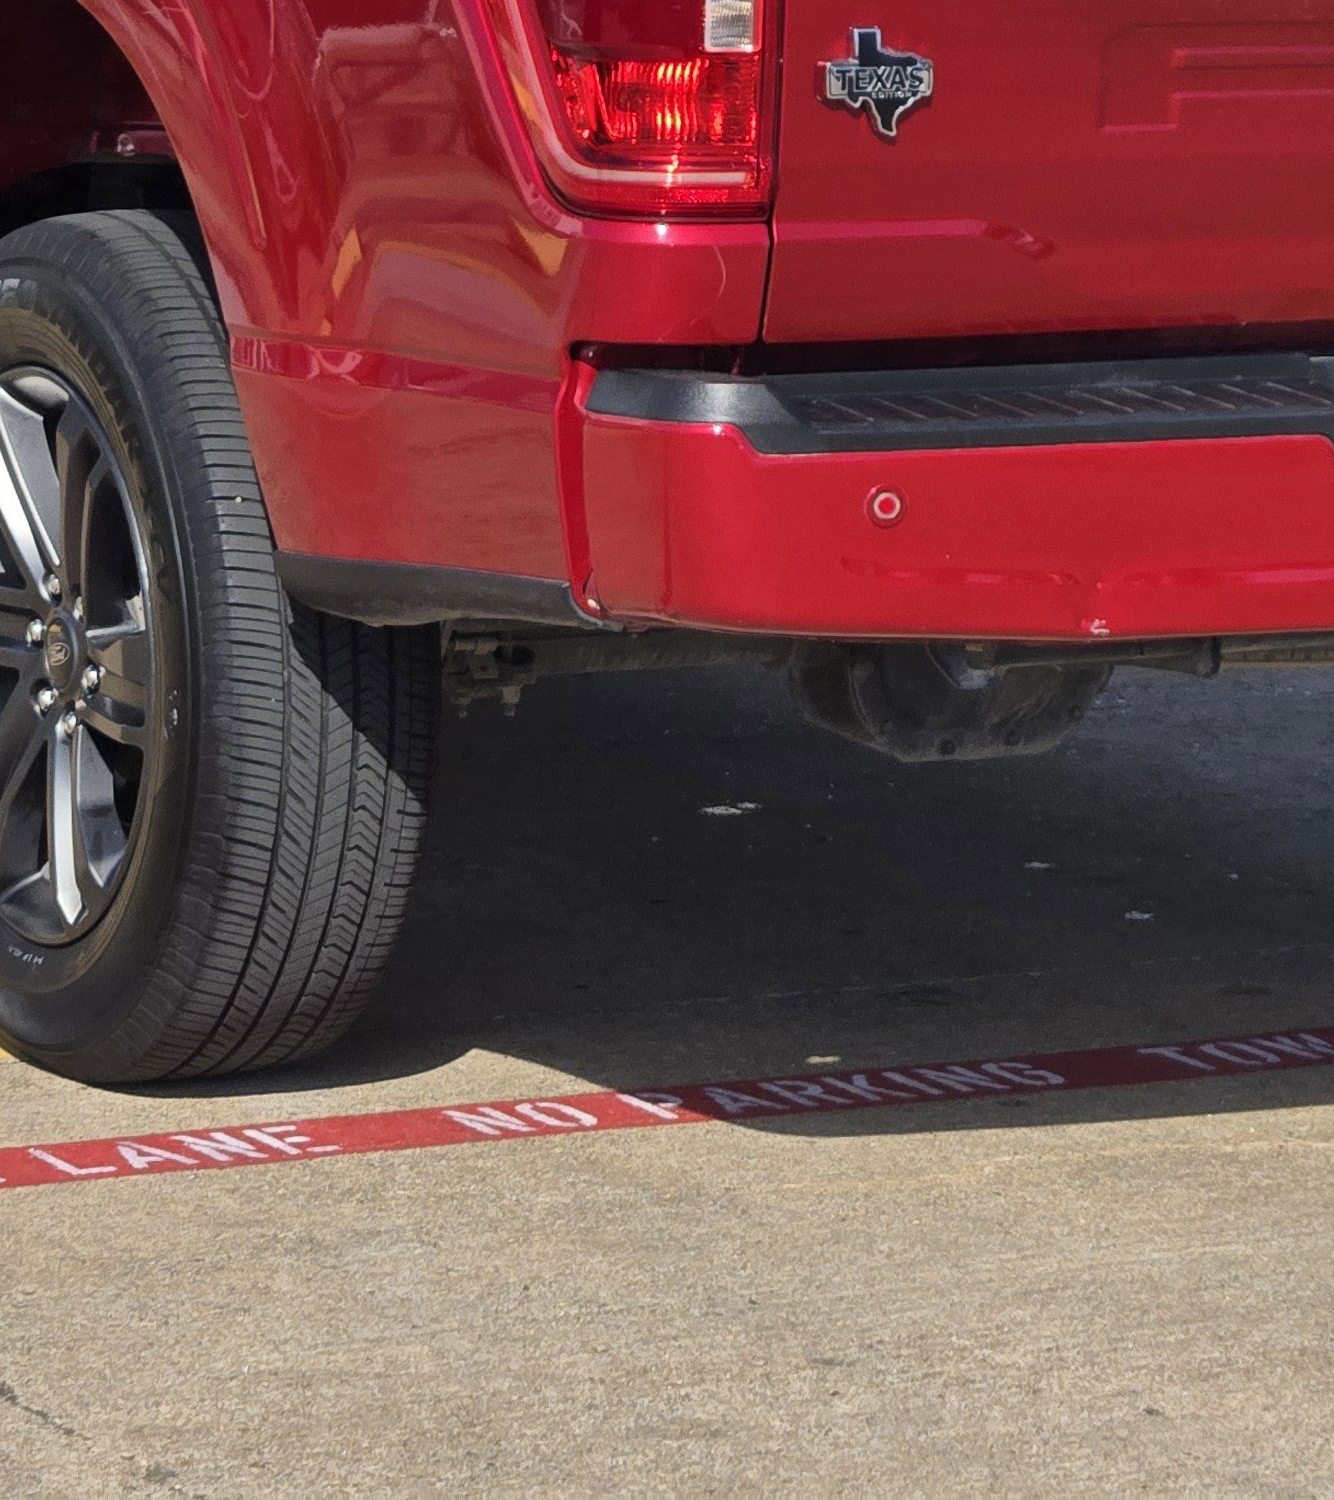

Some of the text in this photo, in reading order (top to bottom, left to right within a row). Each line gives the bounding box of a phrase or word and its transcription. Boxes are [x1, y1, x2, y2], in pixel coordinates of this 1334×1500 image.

[835, 66, 924, 92] TEXAS
[28, 1125, 341, 1176] LANE
[441, 1102, 598, 1136] NO
[615, 1061, 1065, 1120] PARKING
